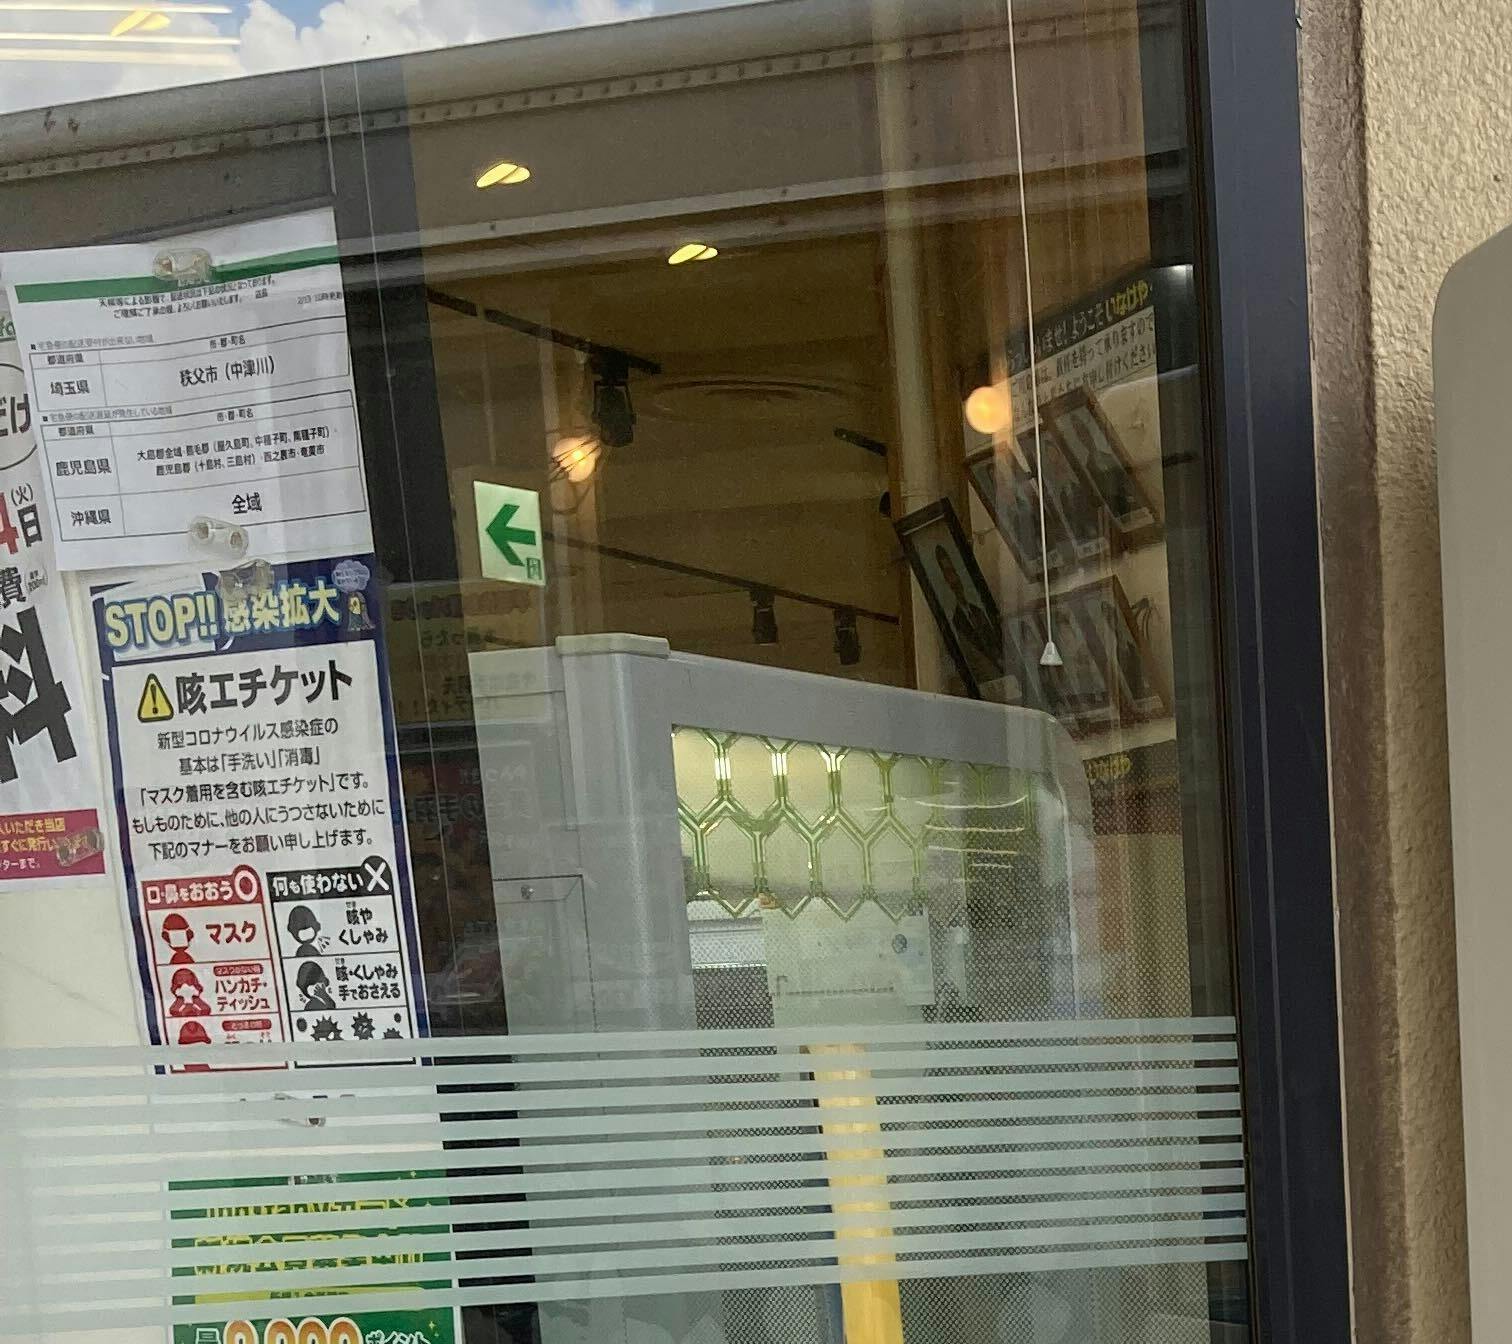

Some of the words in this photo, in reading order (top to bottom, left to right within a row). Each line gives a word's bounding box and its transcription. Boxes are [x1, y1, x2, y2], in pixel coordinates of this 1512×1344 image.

[50, 380, 90, 397] 埼玉県
[56, 458, 112, 477] 鹿児島県
[231, 492, 263, 515] 全域
[71, 508, 111, 527] 沖縄県
[104, 593, 218, 648] STOP!!
[223, 579, 341, 633] 感染拡大
[175, 659, 353, 715] 咳エチケット
[157, 718, 339, 750] 新型コロナウイルス感染症の
[178, 746, 321, 776] 基本は「手洗い」「消毒」
[140, 772, 369, 806] 「マスク着用を含む咳エチケット」です。
[0, 816, 66, 836] いただき当店
[132, 799, 386, 833] もしものために、他の人にうつさないために
[148, 828, 373, 861] 下記のマナーをお願い申し上げます。
[145, 880, 232, 905] 口・鼻をおおう
[272, 872, 364, 897] 何も使わない
[205, 920, 257, 945] マスク
[339, 927, 389, 946] くしゃみ
[335, 962, 398, 982] 咳・くしゃみ
[216, 994, 271, 1012] ティッシュ
[338, 982, 401, 1002] 手でおさえる
